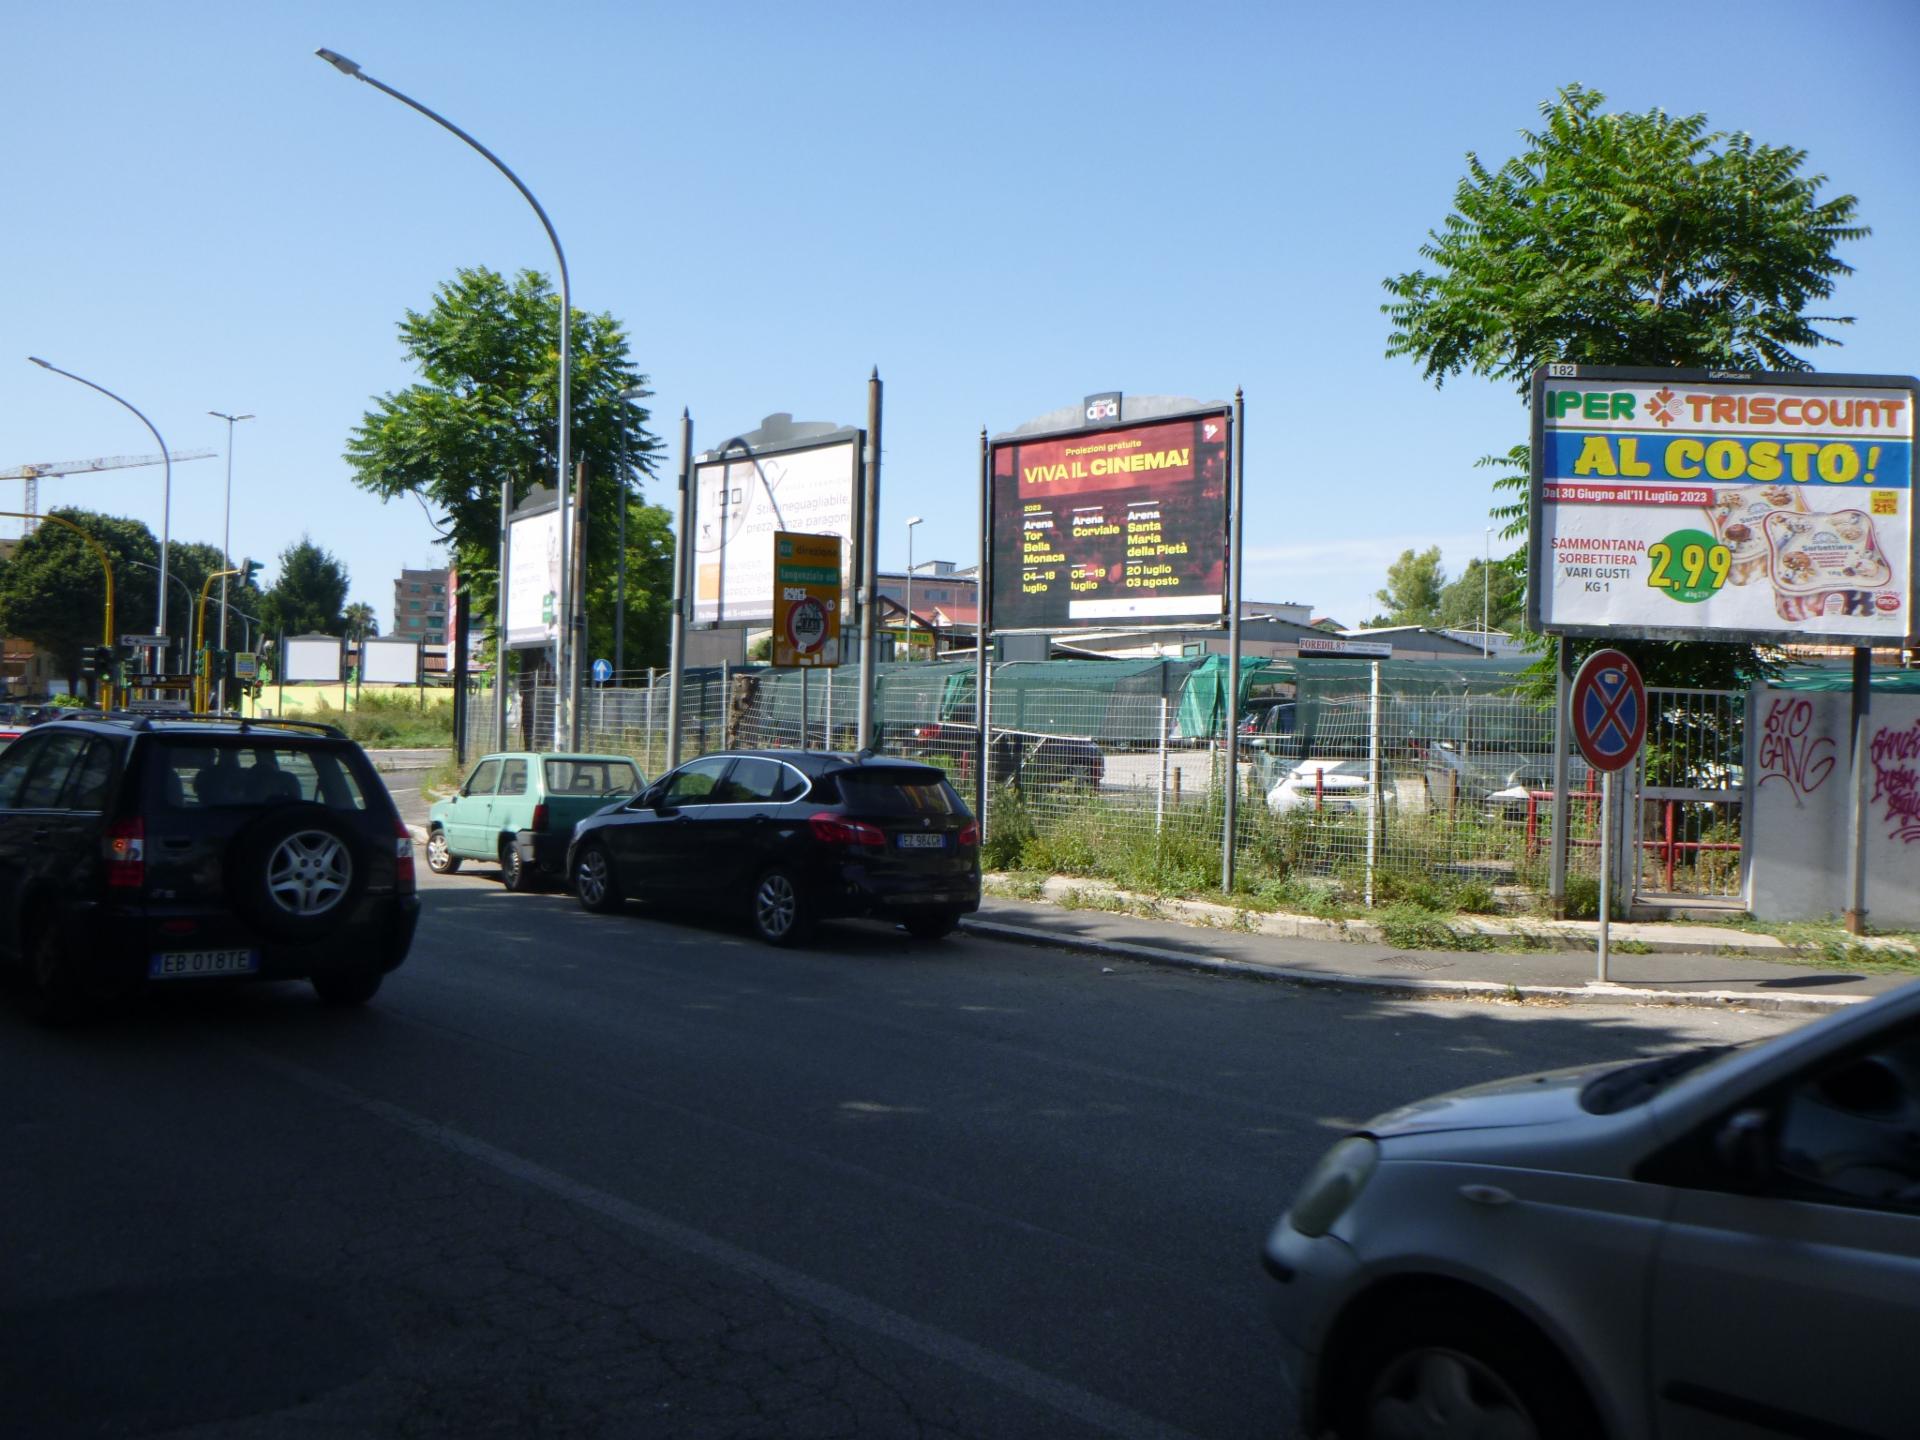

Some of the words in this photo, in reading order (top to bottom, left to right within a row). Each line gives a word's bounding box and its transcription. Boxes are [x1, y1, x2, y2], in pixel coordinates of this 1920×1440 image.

[1552, 365, 1574, 376] 182
[1086, 402, 1117, 421] apa
[1546, 390, 1636, 421] IPER
[1065, 443, 1106, 457] Proiezioni
[1107, 440, 1141, 454] gratuite
[1023, 464, 1069, 484] VIVA
[1072, 462, 1088, 479] IL
[1090, 448, 1190, 476] CINEMA!
[1574, 436, 1651, 478] AL
[1664, 439, 1882, 484] COSTO!
[1543, 488, 1560, 498] Dal
[1561, 488, 1575, 499] 30
[1577, 488, 1615, 501] Giugno
[1616, 489, 1642, 500] all'11
[1645, 491, 1678, 503] Luglio
[1681, 491, 1707, 502] 2023
[1024, 504, 1042, 512] 2023
[1072, 515, 1104, 526] Arena
[1127, 510, 1160, 521] Arena
[1023, 520, 1054, 530] Arena
[1072, 524, 1120, 537] Corviale
[1127, 522, 1161, 533] Santa
[1024, 531, 1044, 541] Tor
[1127, 533, 1161, 545] Maria
[1023, 542, 1051, 552] Bella
[1127, 545, 1156, 558] della
[1156, 542, 1188, 555] Pietà
[1551, 537, 1645, 551] SAMMONTANA
[1023, 553, 1065, 564] Monaca
[1558, 552, 1637, 566] SORBETTIERA
[1126, 566, 1142, 576] 20
[1143, 564, 1172, 576] luglio
[1565, 567, 1592, 578] VARI
[1595, 568, 1630, 579] GUSTI
[1647, 542, 1732, 592] 2,99
[1022, 583, 1048, 594] luglio
[1071, 580, 1098, 592] luglio
[1126, 577, 1142, 588] 03
[1142, 576, 1180, 589] agosto
[1584, 582, 1600, 592] KG
[1604, 582, 1610, 592] 1
[1300, 639, 1335, 651] FOREDIL
[1759, 733, 1836, 793] GANG
[165, 954, 186, 972] EB
[193, 951, 249, 971] 018TE
